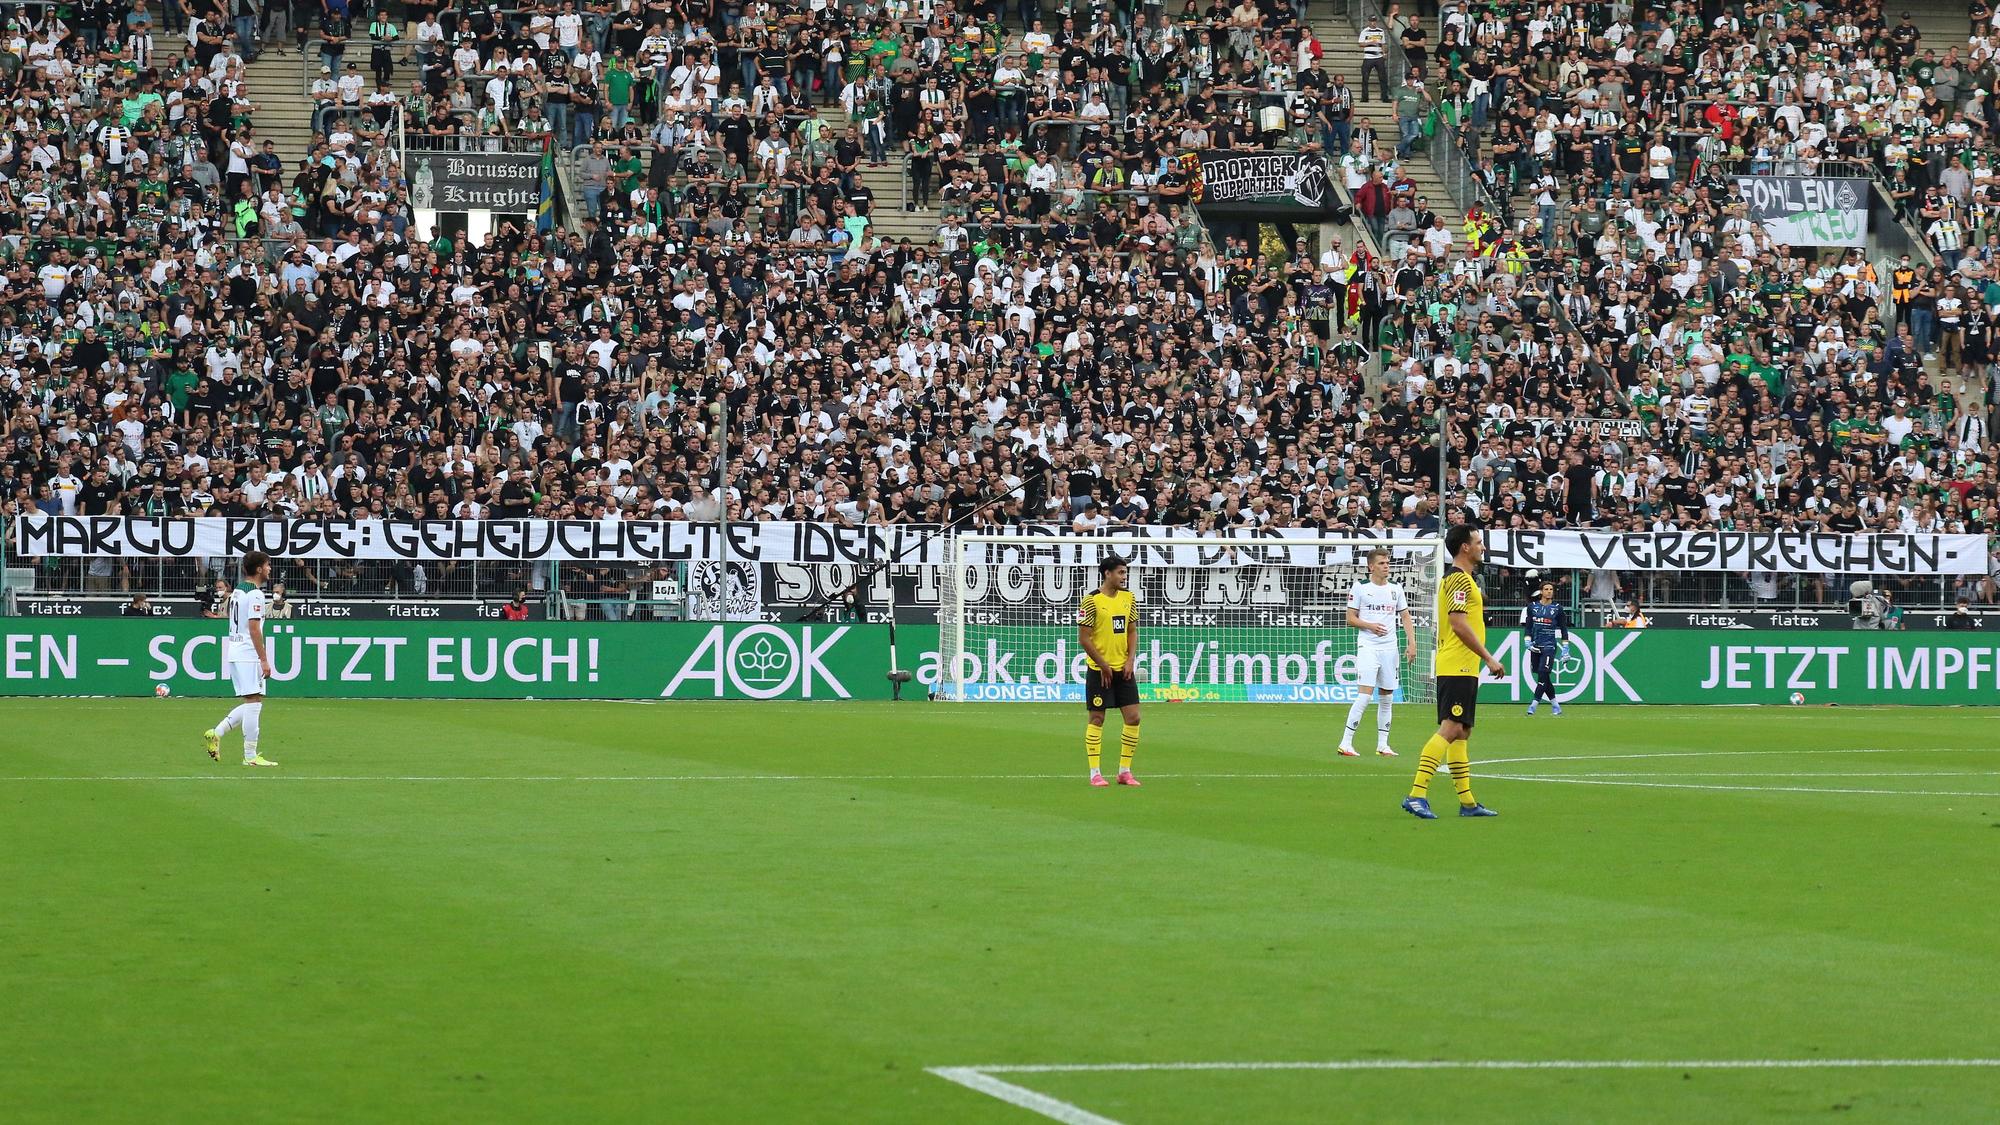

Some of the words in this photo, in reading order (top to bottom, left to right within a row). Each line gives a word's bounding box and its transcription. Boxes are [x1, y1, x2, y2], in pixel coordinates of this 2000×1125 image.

[446, 158, 538, 179] Borussen
[1203, 156, 1296, 185] DROPKICK
[443, 185, 541, 207] Knights
[1213, 176, 1286, 201] SUPPORTERS
[1737, 178, 1835, 212] FOHLEN
[1788, 208, 1859, 242] TREU
[21, 516, 195, 556] MARCO
[225, 518, 371, 558] ROSE:
[383, 519, 761, 561] GEHEUCHELTE
[655, 586, 677, 595] 16/1
[29, 602, 82, 615] flatex
[119, 602, 172, 615] fex
[298, 604, 351, 616] flatex
[387, 605, 440, 617] flatex
[825, 610, 890, 624] flex
[933, 609, 1000, 624] fltex
[1150, 610, 1216, 626] flatex
[1258, 612, 1323, 627] flatex
[1604, 613, 1654, 626] flx
[1687, 614, 1737, 626] flatex
[1769, 615, 1819, 627] flatex
[1934, 616, 1983, 627] flx
[149, 624, 407, 681] SCÜTZT
[428, 637, 599, 683] EUCH!
[660, 624, 852, 699] AOK
[1701, 646, 1849, 689] JETZT
[1867, 647, 2000, 690] IMPF
[975, 685, 1061, 699] JONGEN
[1290, 685, 1358, 700] JONGE
